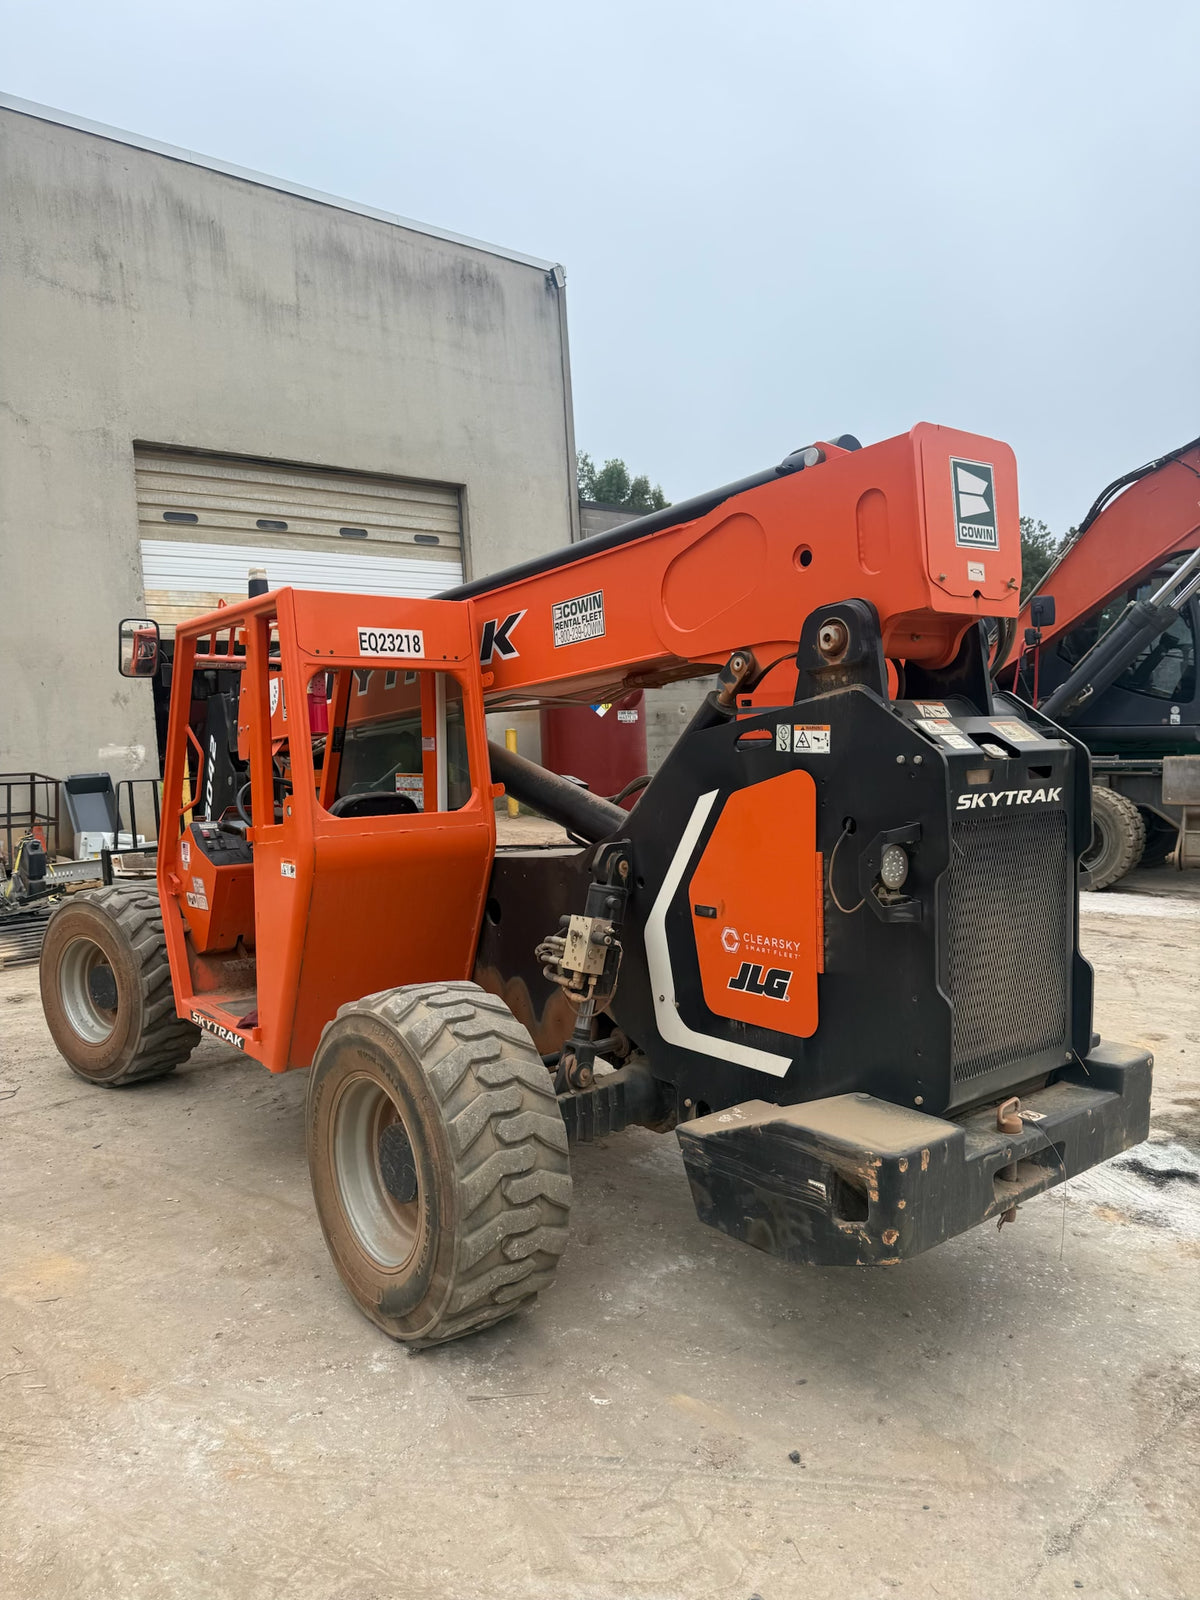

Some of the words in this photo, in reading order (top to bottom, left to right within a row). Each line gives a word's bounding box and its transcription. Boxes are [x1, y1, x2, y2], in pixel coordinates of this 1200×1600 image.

[961, 526, 993, 541] COWIN
[562, 594, 602, 618] COWIN
[554, 617, 581, 631] RENTAL
[581, 610, 602, 624] FLEET
[358, 632, 421, 654] EQ23218
[956, 787, 1062, 810] SKYTRAK
[743, 932, 800, 952] CLEARSKY
[745, 944, 770, 954] SMART
[773, 949, 799, 959] FLEET
[727, 961, 793, 1001] JLG
[191, 1011, 242, 1048] SKYTRAK
